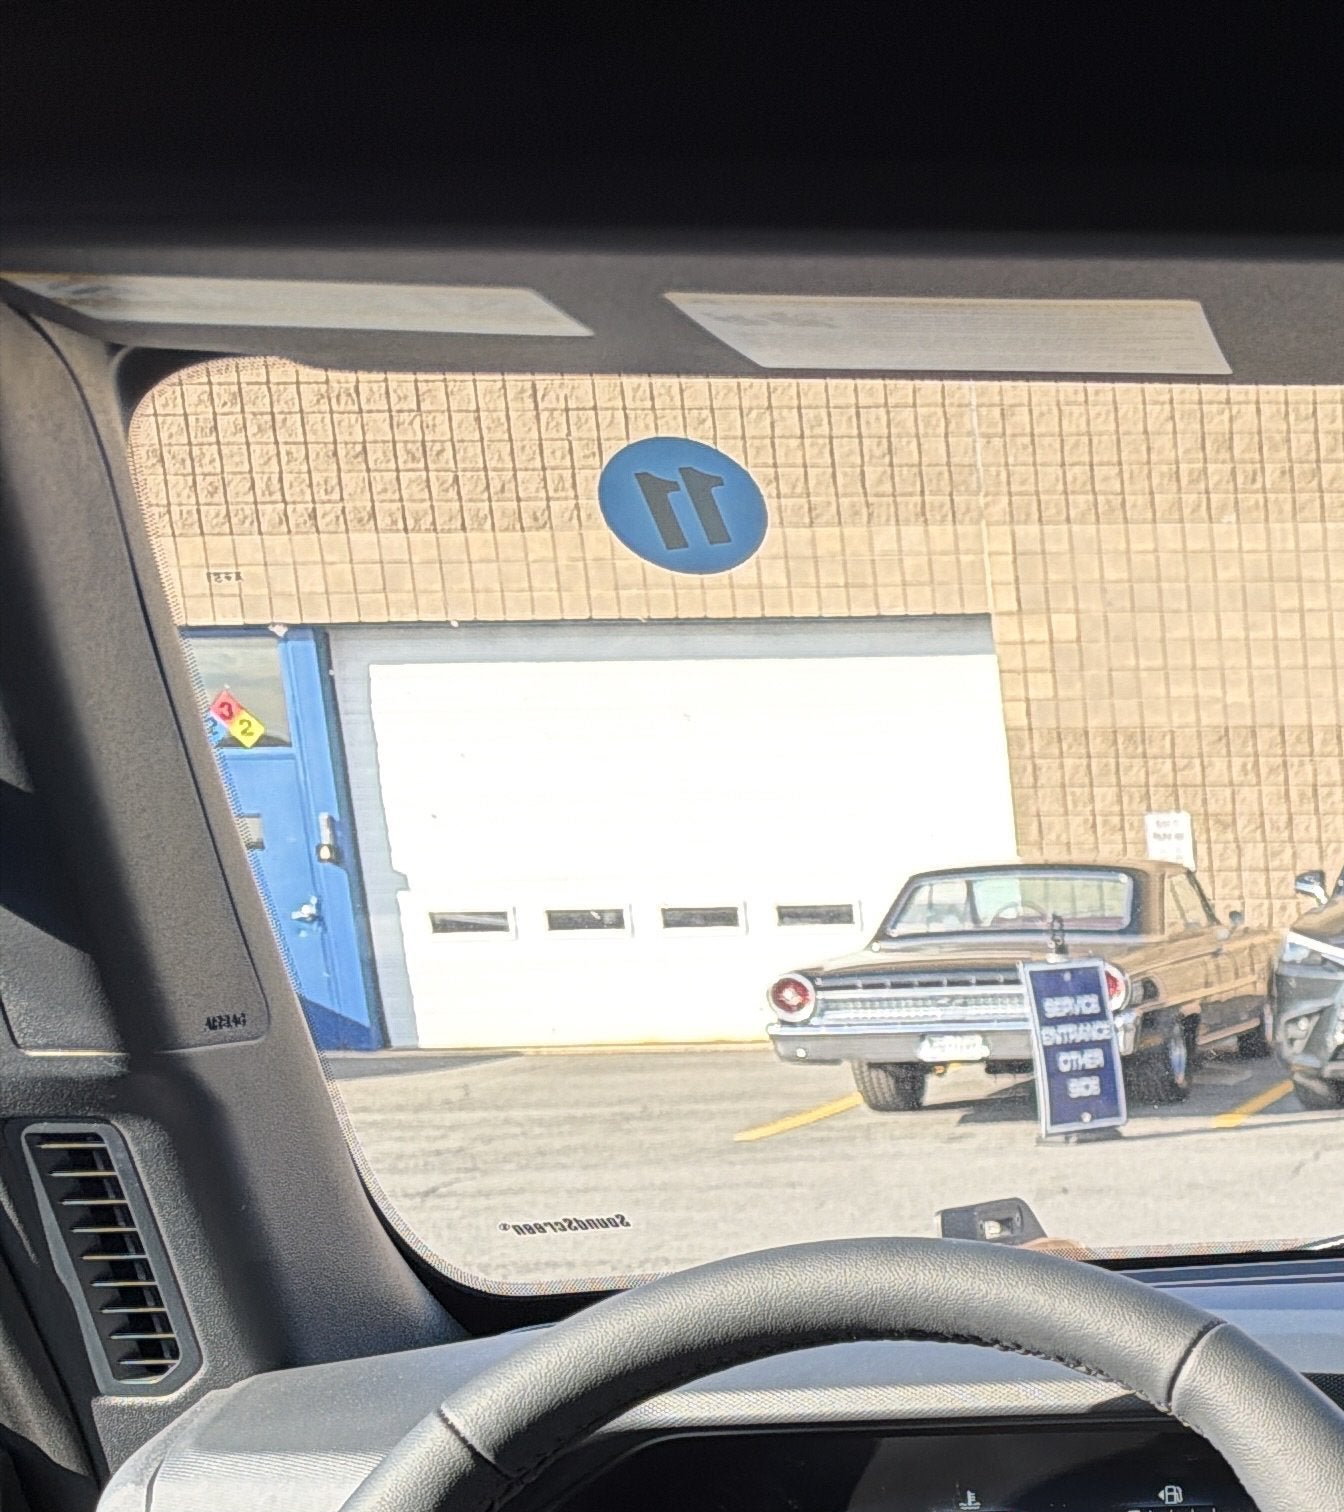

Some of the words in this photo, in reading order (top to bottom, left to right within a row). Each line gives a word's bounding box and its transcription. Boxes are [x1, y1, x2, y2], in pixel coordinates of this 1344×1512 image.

[219, 701, 234, 720] 3
[239, 718, 254, 736] 2
[1043, 994, 1101, 1019] SERVICE
[1041, 1020, 1114, 1046] ENTRANCE
[1057, 1048, 1104, 1073] OTHER
[1067, 1075, 1101, 1099] SIDE
